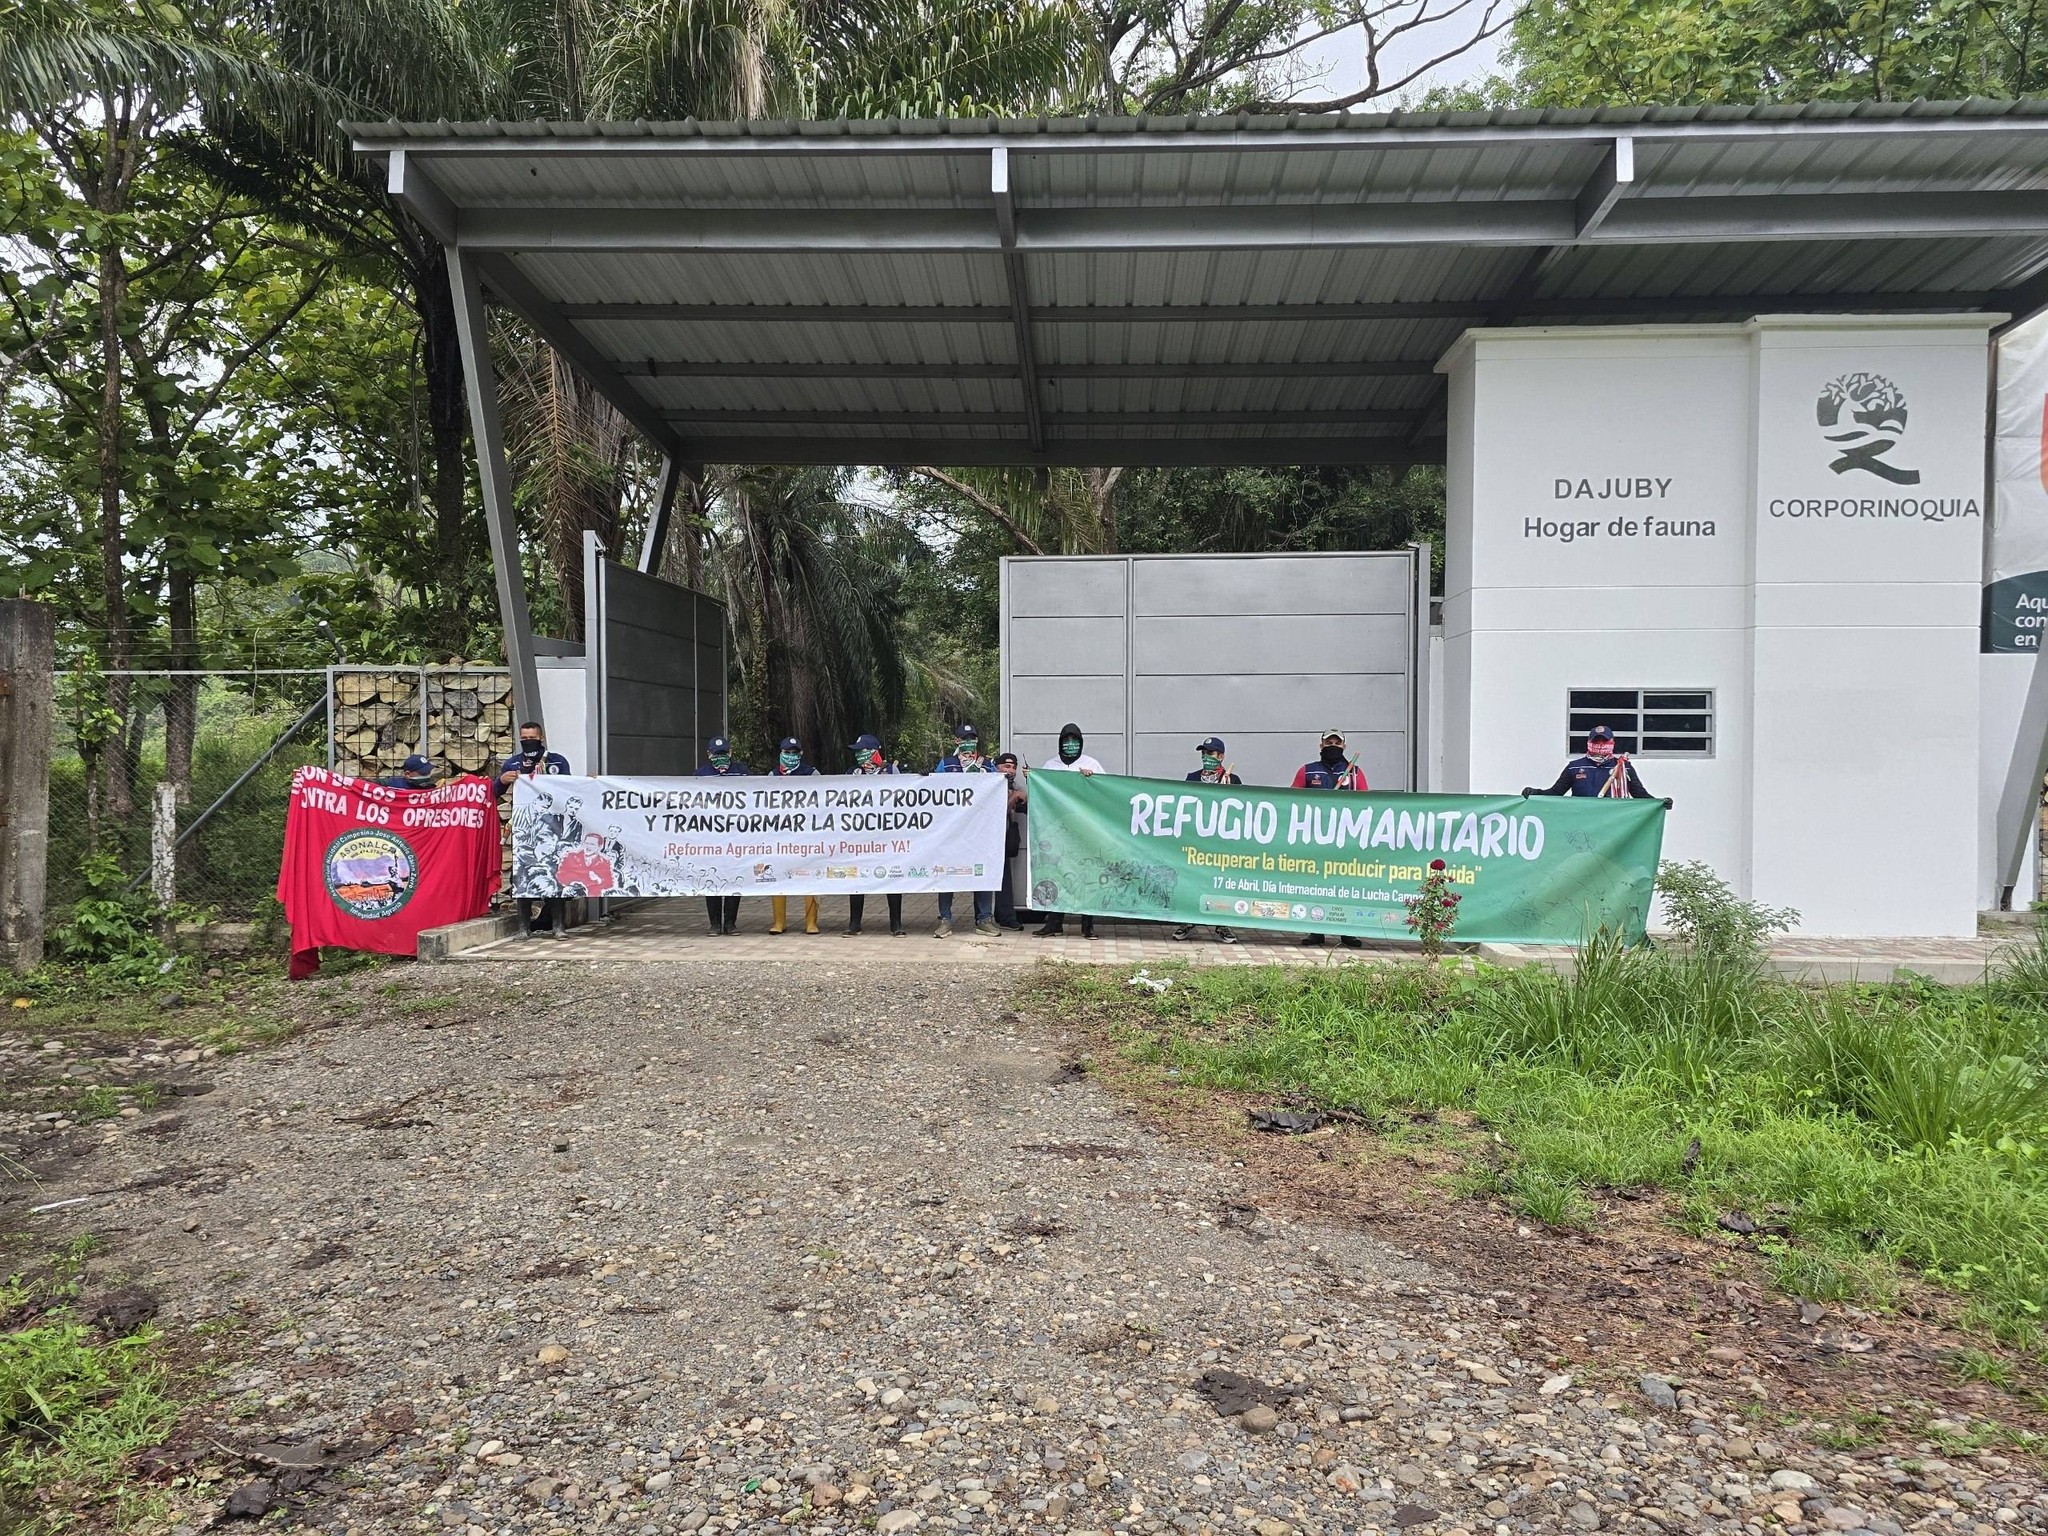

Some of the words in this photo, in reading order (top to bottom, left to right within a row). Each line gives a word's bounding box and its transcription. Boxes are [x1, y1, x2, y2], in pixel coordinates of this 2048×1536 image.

[1554, 477, 1673, 500] DAJUBY
[1769, 498, 1980, 522] CORPORINOQUIA
[1524, 516, 1601, 543] Hogar
[1607, 515, 1639, 537] de
[1643, 515, 1716, 537] fauna
[2014, 634, 2037, 646] en
[301, 787, 347, 816] ONTRA
[356, 800, 390, 825] LOS
[403, 807, 485, 829] OPRESORES
[601, 790, 747, 810] RECUPERAMOS
[752, 789, 819, 809] TIERRA
[825, 789, 873, 808] PARA
[879, 788, 974, 807] PRODUCIR
[644, 814, 657, 832] Y
[662, 814, 806, 833] TRANSFORMAR
[811, 813, 835, 832] LA
[841, 812, 933, 831] SOCIEDAD
[1129, 793, 1278, 845] REFUGIO
[1287, 803, 1545, 861] HUMANITARIO
[663, 842, 722, 859] ¡Reforma
[726, 842, 772, 858] Agraria
[777, 841, 825, 857] Integral
[828, 844, 836, 857] y
[839, 840, 887, 856] Popular
[891, 840, 910, 853] YA!
[1182, 846, 1259, 872] "Recuperar
[1262, 852, 1275, 871] la
[1278, 853, 1320, 875] tierra,
[1323, 858, 1386, 879] producir
[1388, 864, 1422, 884] para
[1212, 876, 1223, 889] 17
[1225, 878, 1236, 890] de
[1262, 881, 1276, 893] Día
[1279, 881, 1336, 897] Internacional
[1338, 886, 1350, 898] de
[1351, 886, 1360, 899] la
[1362, 887, 1390, 901] Lucha
